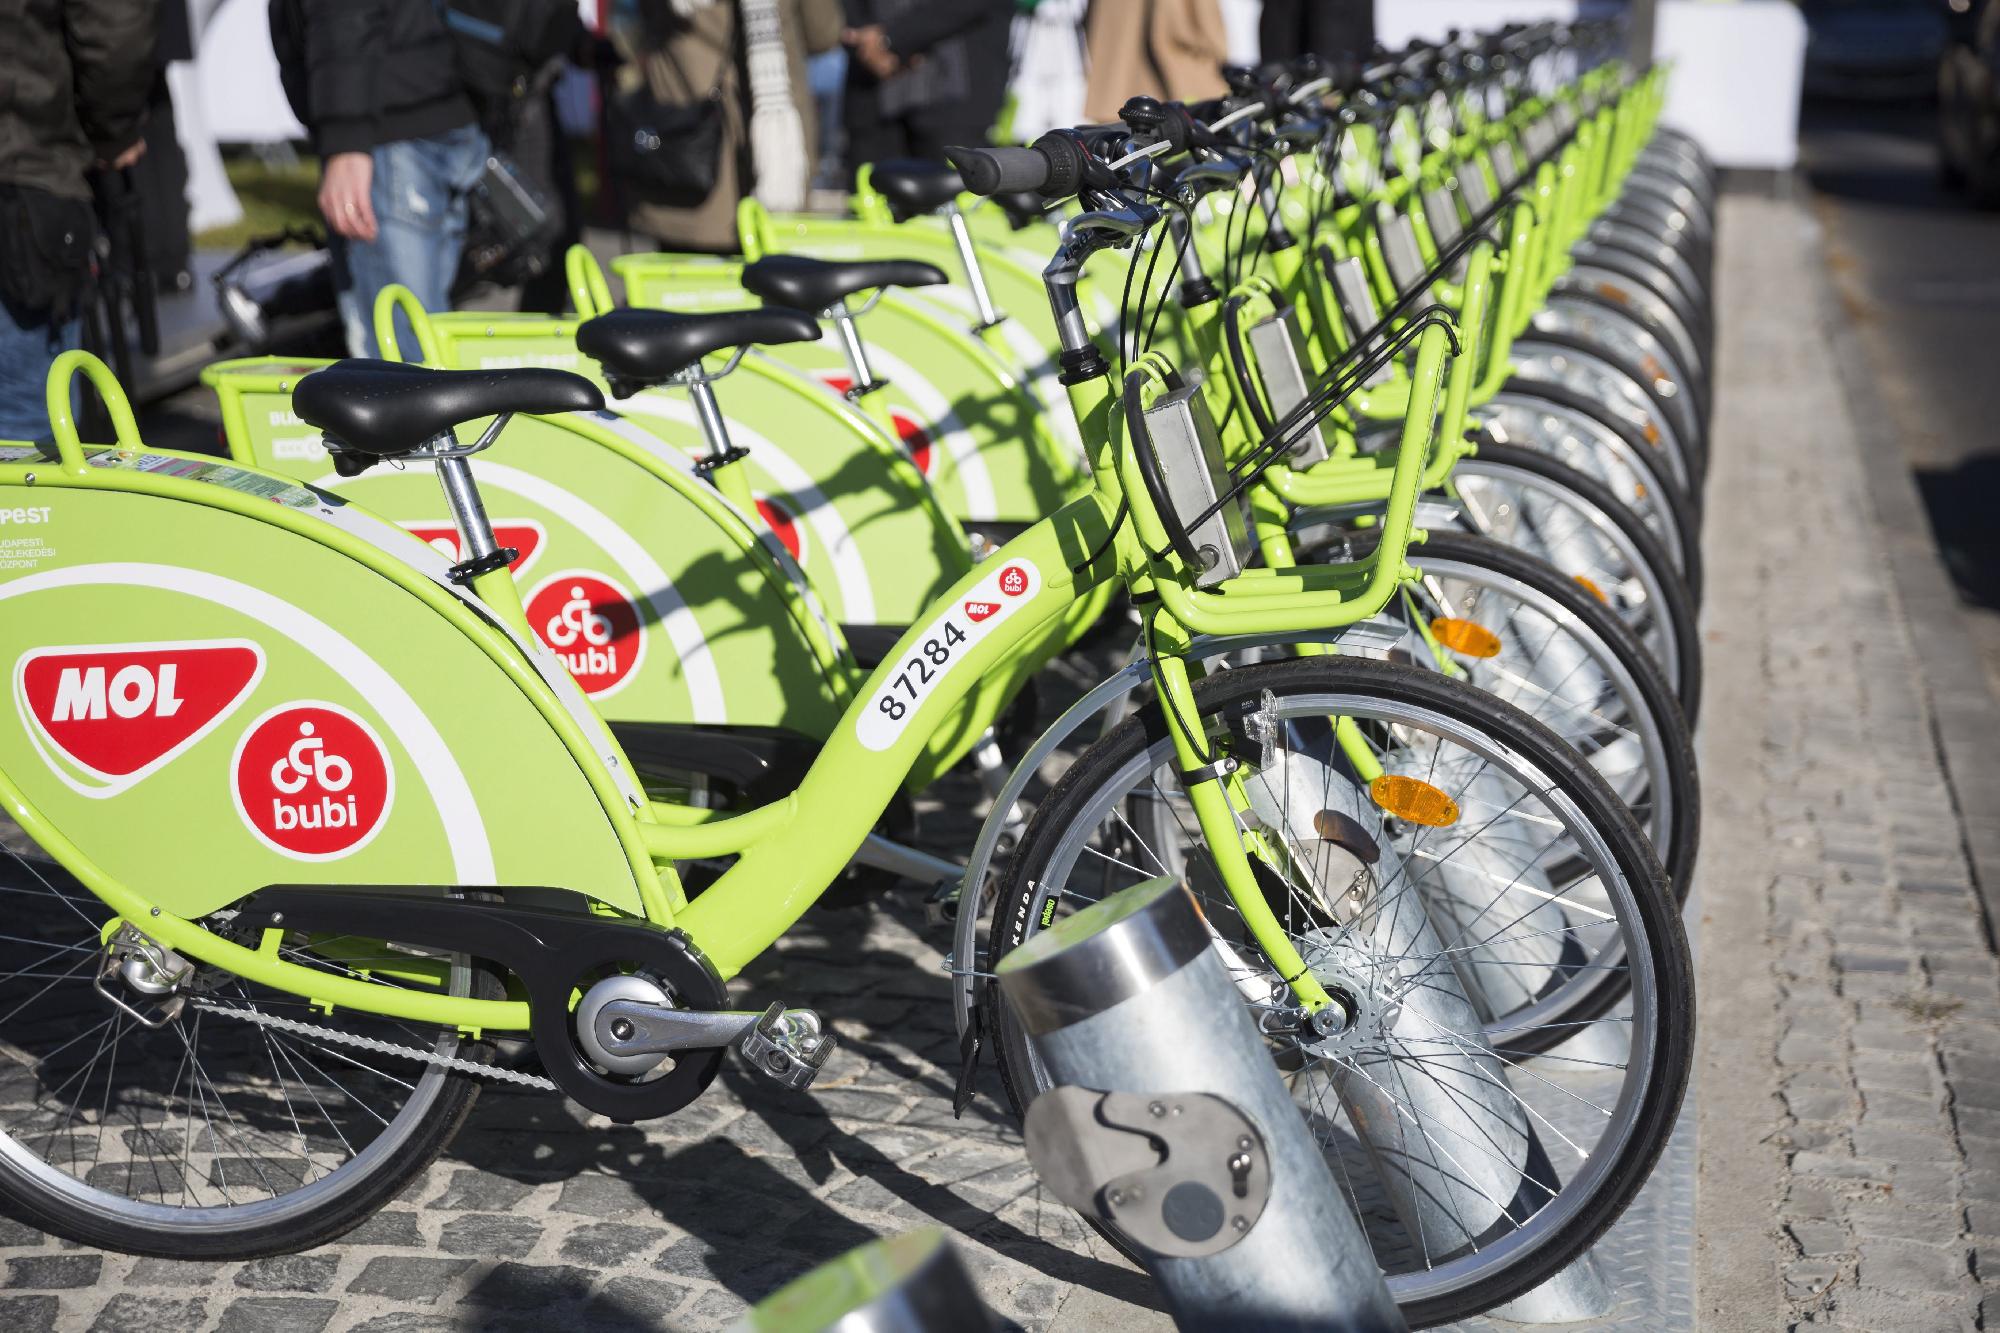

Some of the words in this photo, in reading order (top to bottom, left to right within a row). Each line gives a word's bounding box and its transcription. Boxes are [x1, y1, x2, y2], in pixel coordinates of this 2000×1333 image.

[967, 603, 990, 615] MOL
[1004, 583, 1022, 592] bubi
[51, 663, 185, 722] MOL
[879, 620, 967, 721] 87284
[272, 794, 358, 830] bubi
[1012, 880, 1036, 946] KENDA
